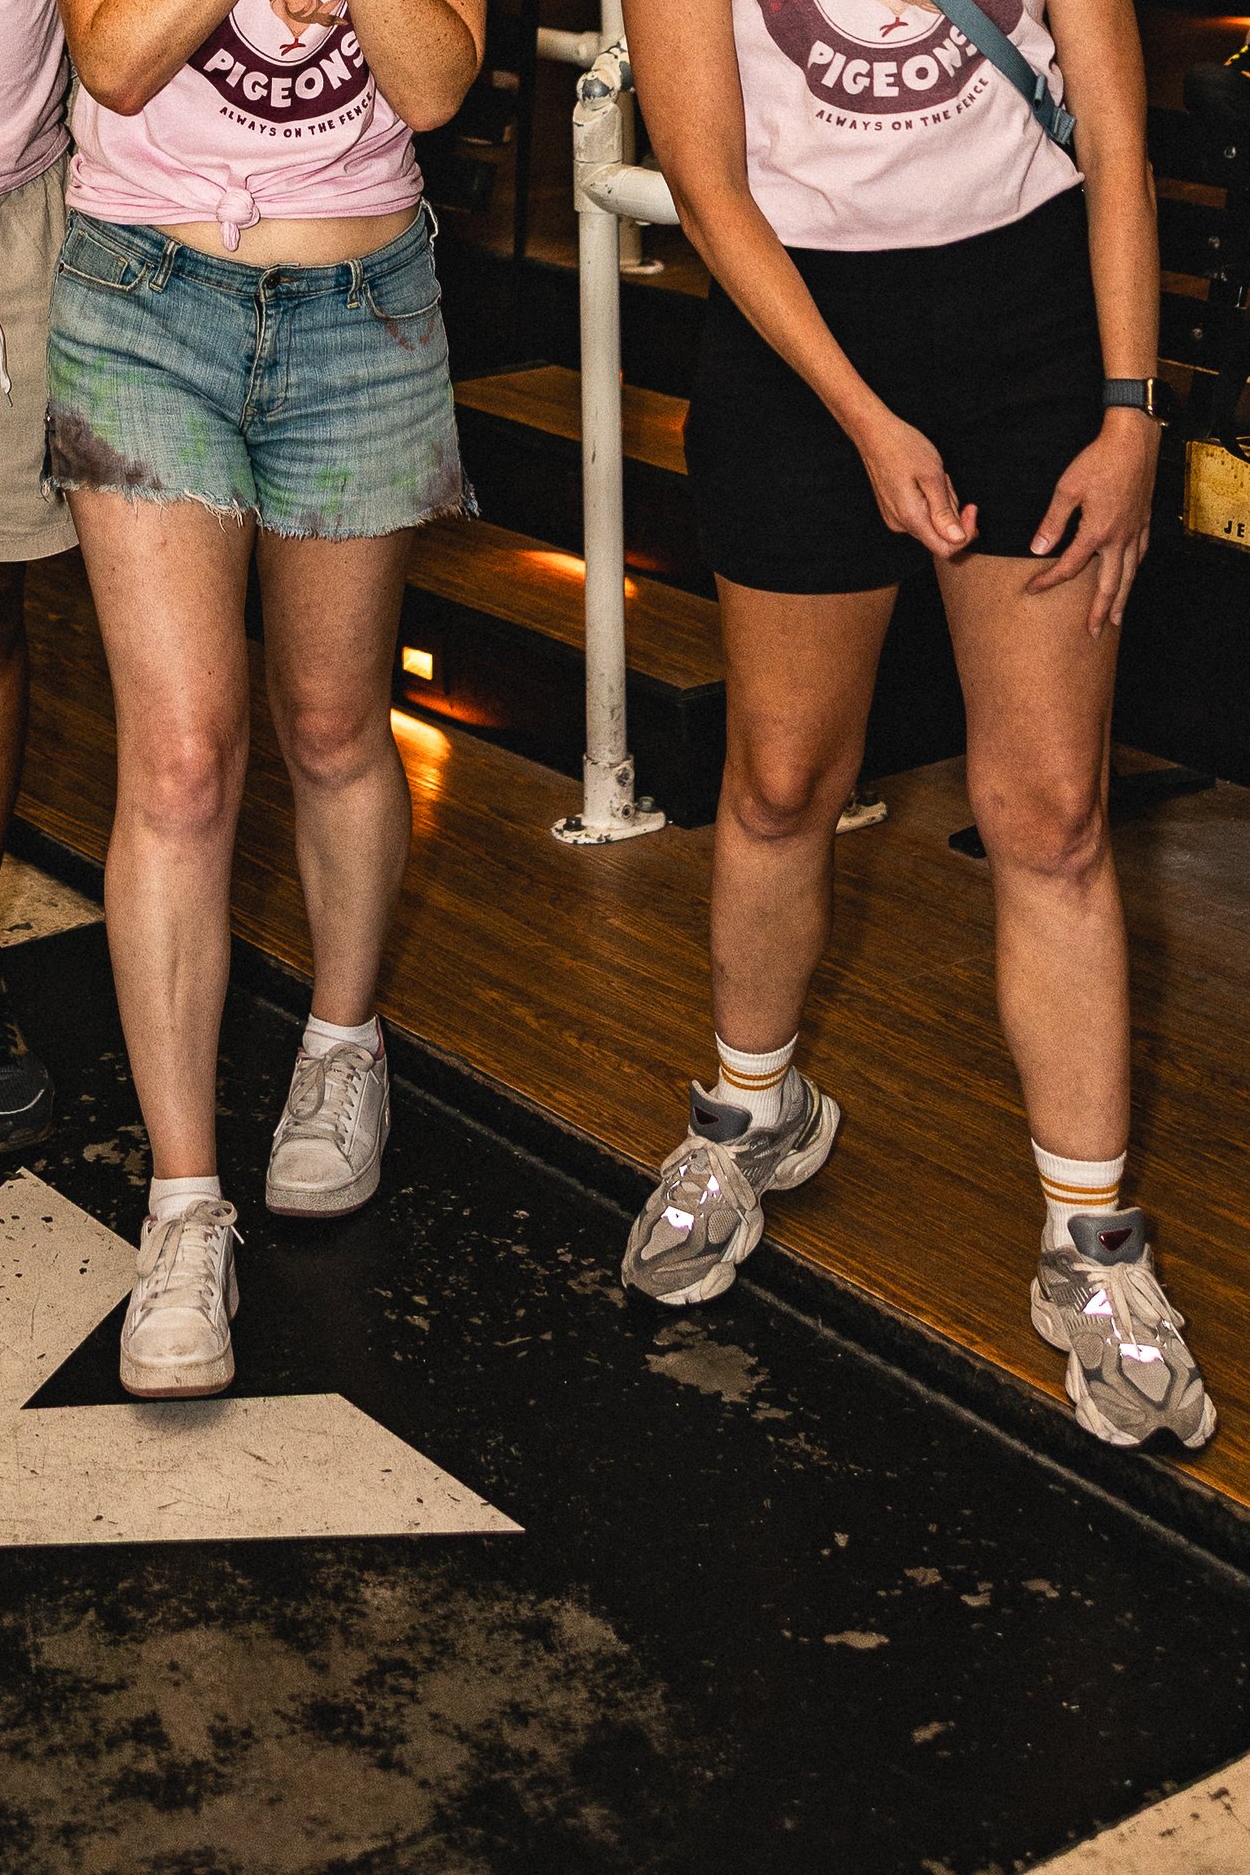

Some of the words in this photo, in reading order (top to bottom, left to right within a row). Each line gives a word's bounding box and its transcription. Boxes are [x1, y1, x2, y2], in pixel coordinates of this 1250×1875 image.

[219, 107, 277, 137] ALWAYS
[283, 128, 302, 138] ON
[308, 120, 336, 136] THE
[338, 92, 373, 126] FENCE
[815, 109, 883, 131] ALWAYS
[891, 120, 913, 131] ON
[920, 110, 951, 127] THE
[955, 78, 989, 115] FENCE
